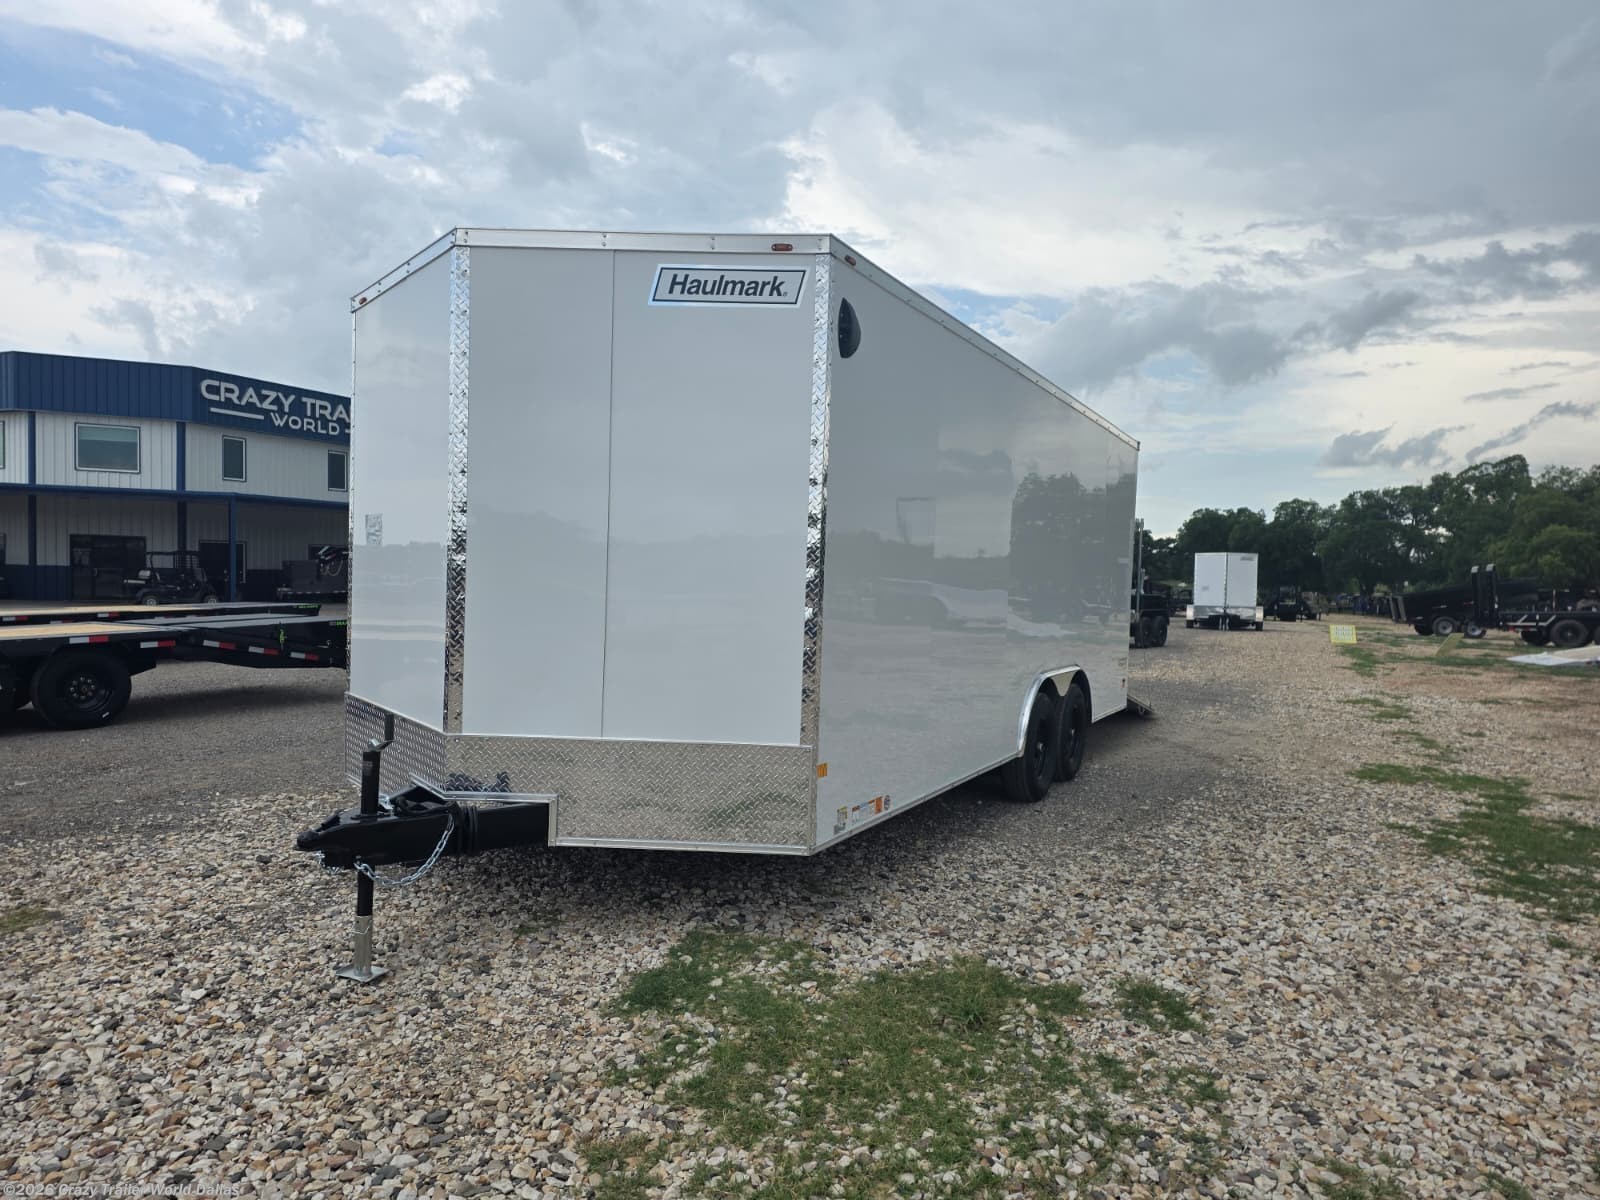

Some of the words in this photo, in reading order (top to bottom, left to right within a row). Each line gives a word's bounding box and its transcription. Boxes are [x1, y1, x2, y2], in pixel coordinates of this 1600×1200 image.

[668, 273, 786, 297] Haulmark
[200, 379, 296, 413] CRAZY
[270, 412, 340, 435] WORLD
